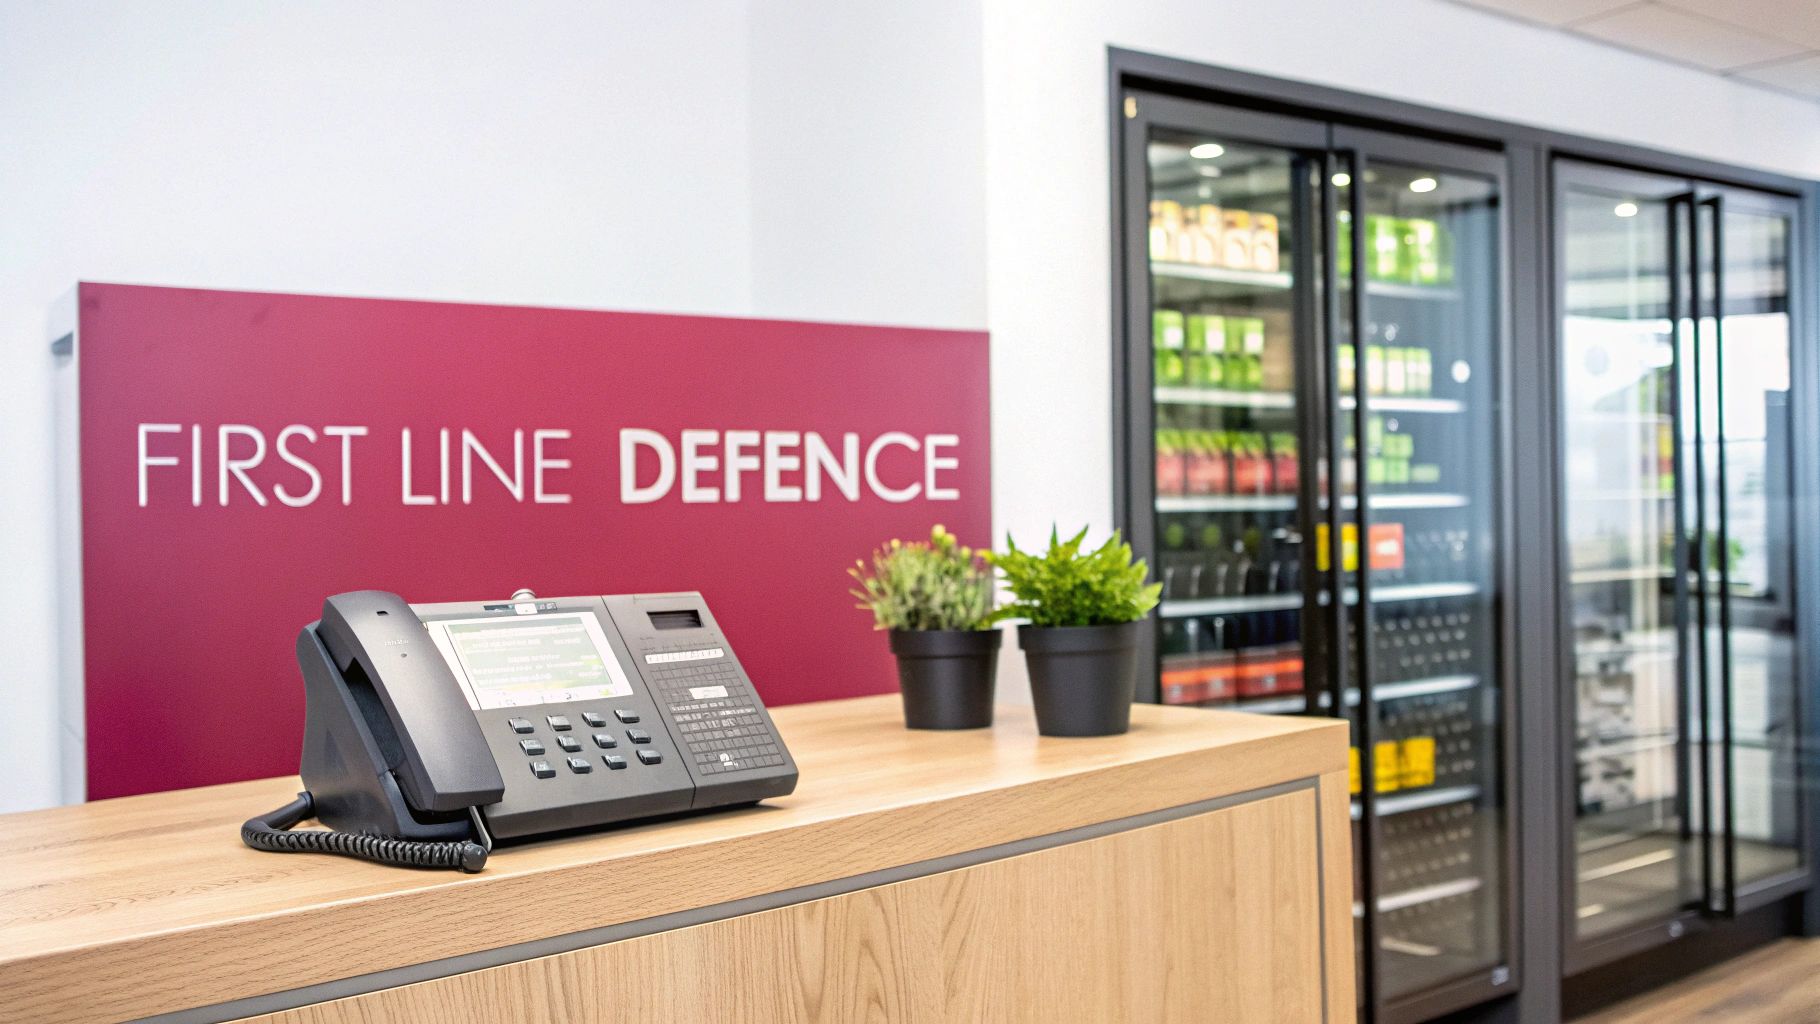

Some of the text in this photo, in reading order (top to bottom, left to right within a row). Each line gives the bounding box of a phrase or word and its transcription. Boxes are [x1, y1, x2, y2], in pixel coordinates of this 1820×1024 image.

[137, 423, 960, 507] FIRST LINE DEFENCE
